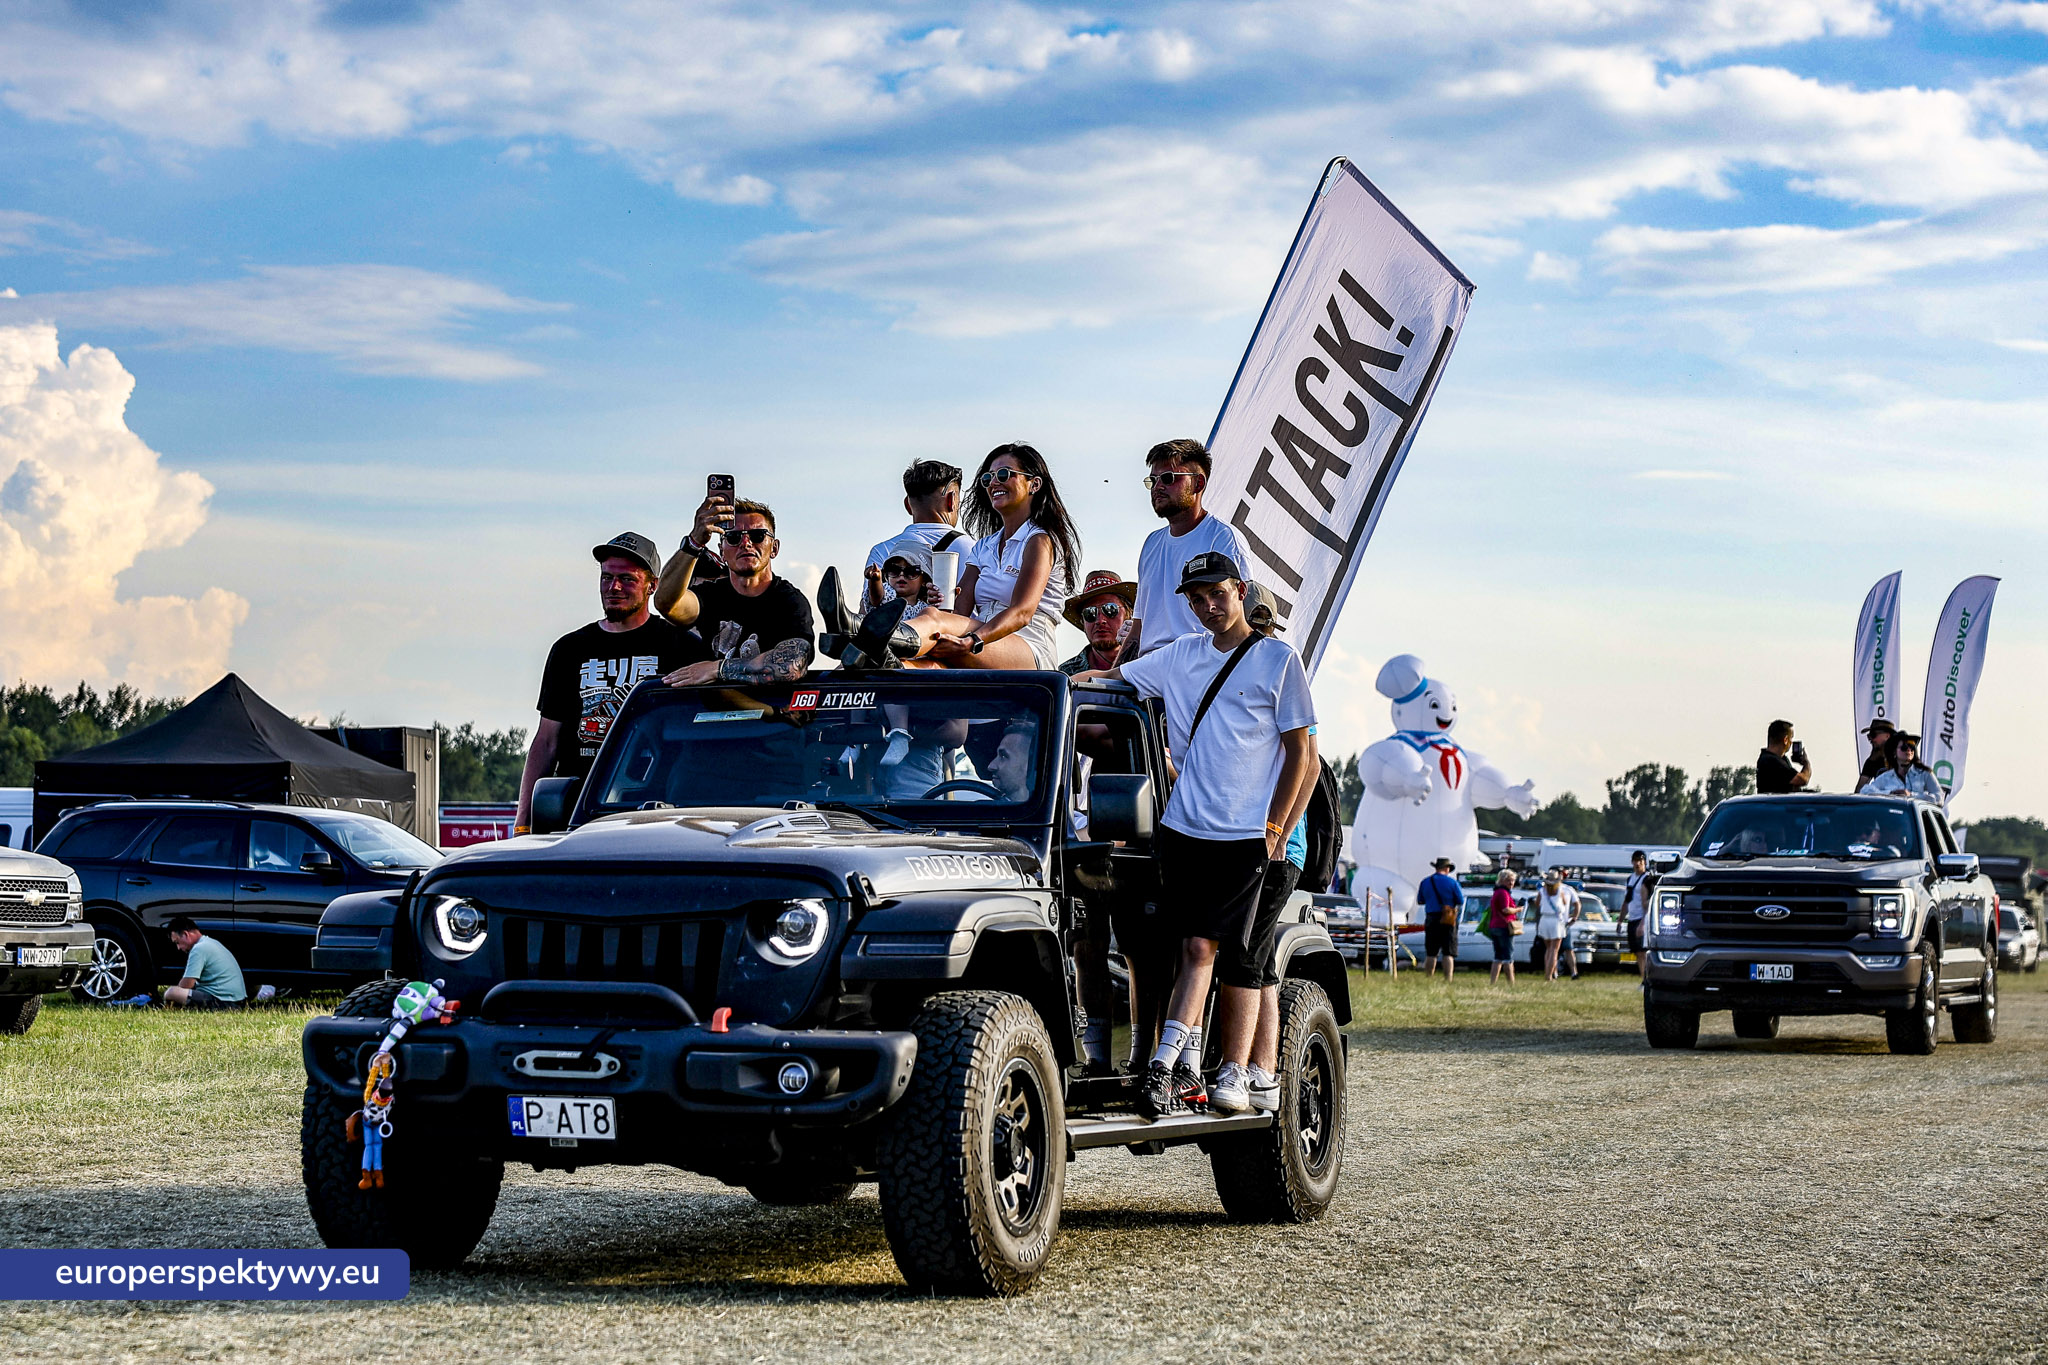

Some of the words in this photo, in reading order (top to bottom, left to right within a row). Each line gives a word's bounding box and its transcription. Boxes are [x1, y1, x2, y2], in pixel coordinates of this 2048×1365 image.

[1230, 269, 1415, 636] TTACK!
[1939, 607, 1972, 752] AutoDiscover
[791, 693, 817, 708] JGD
[821, 692, 877, 711] ATTACK!
[904, 855, 1016, 881] RUBICON
[1762, 907, 1783, 917] Ford
[23, 949, 36, 963] WW
[38, 949, 61, 963] 2979J
[1757, 965, 1766, 978] W
[1770, 965, 1793, 979] 1AD
[512, 1120, 524, 1131] PL
[525, 1100, 544, 1133] P
[557, 1102, 610, 1135] AT8
